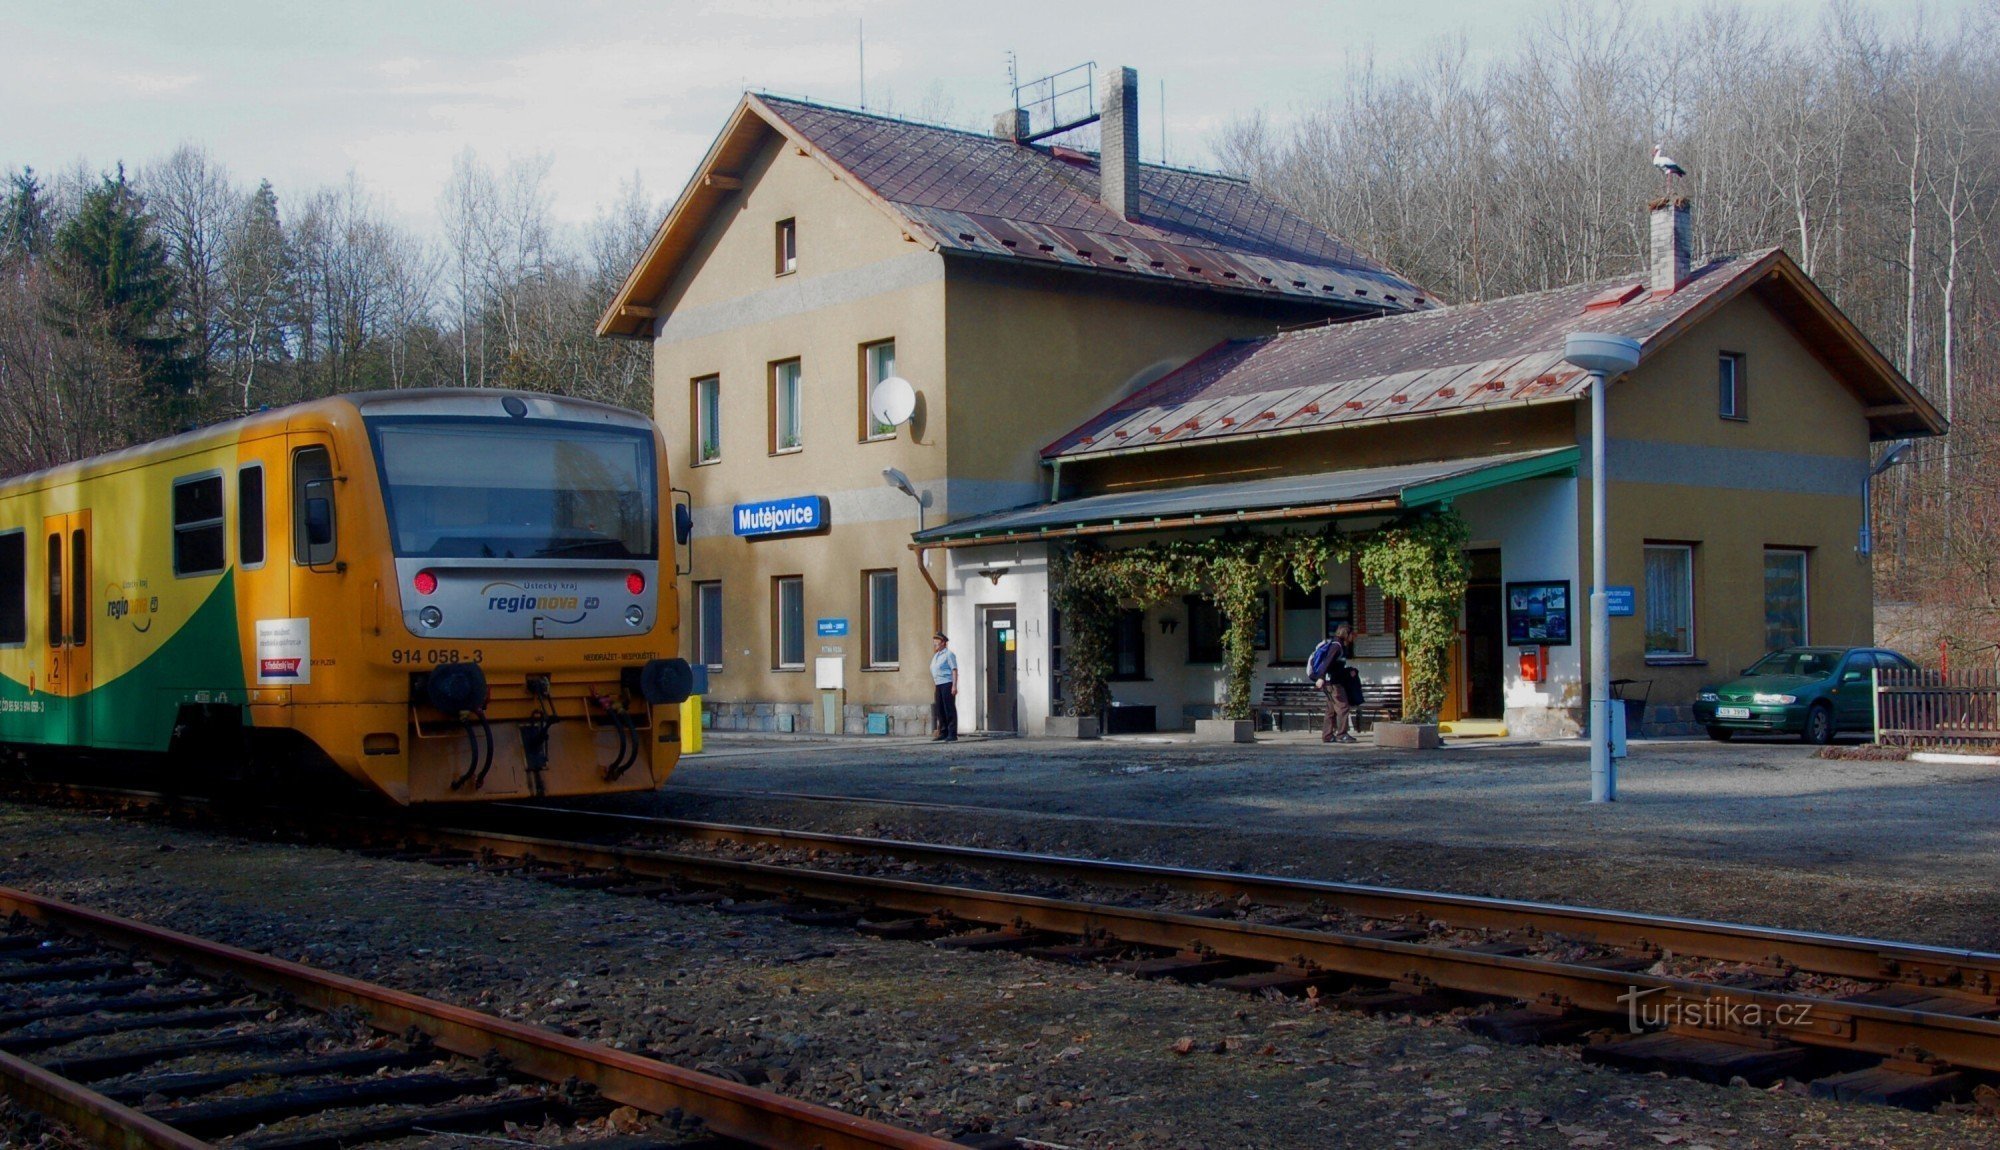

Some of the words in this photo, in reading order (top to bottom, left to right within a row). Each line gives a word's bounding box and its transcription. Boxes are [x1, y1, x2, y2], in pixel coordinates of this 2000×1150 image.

[739, 503, 813, 532] Mutějovice
[524, 581, 557, 591] Ústecký
[561, 582, 578, 591] kraj
[488, 594, 579, 613] regionova
[392, 649, 421, 664] 914
[53, 657, 59, 679] 2
